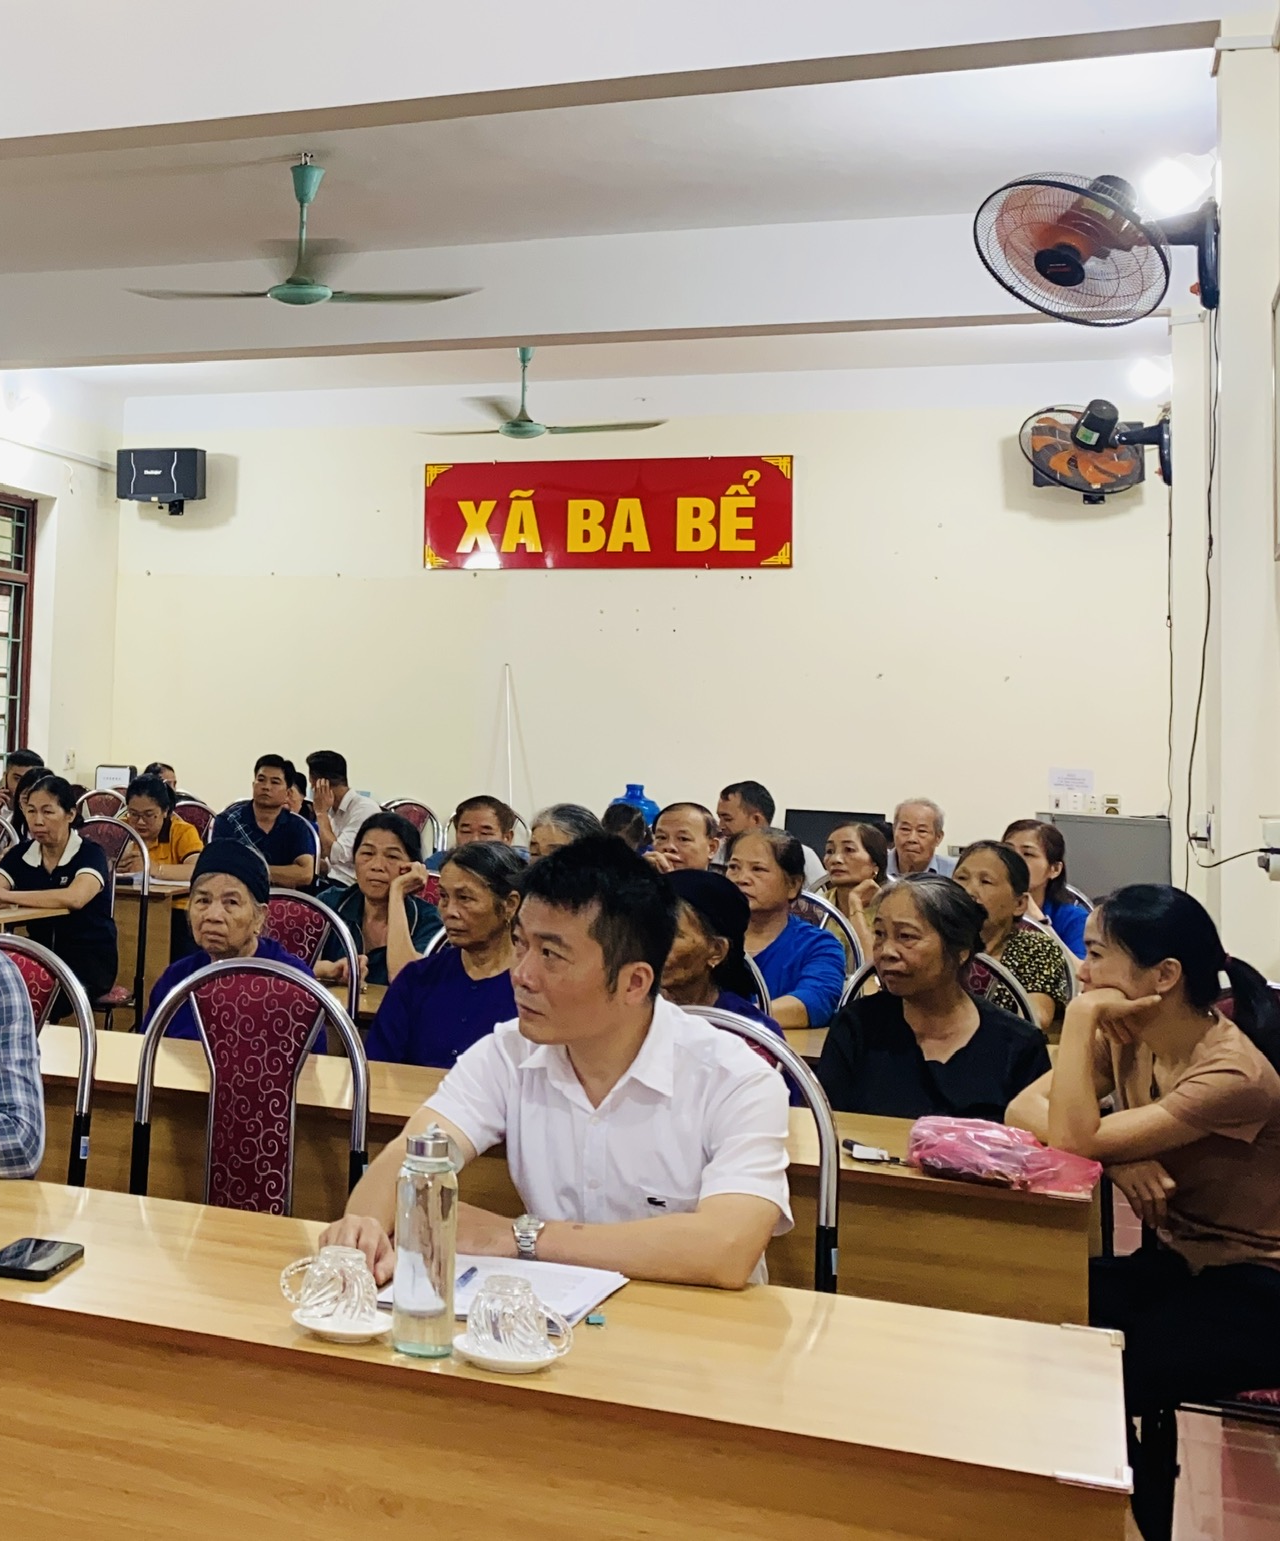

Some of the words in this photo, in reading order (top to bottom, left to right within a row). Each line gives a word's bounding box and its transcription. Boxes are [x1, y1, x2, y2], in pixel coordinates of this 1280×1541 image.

[456, 489, 543, 553] XÃ
[566, 498, 651, 553] BA
[676, 469, 761, 552] BỂ
